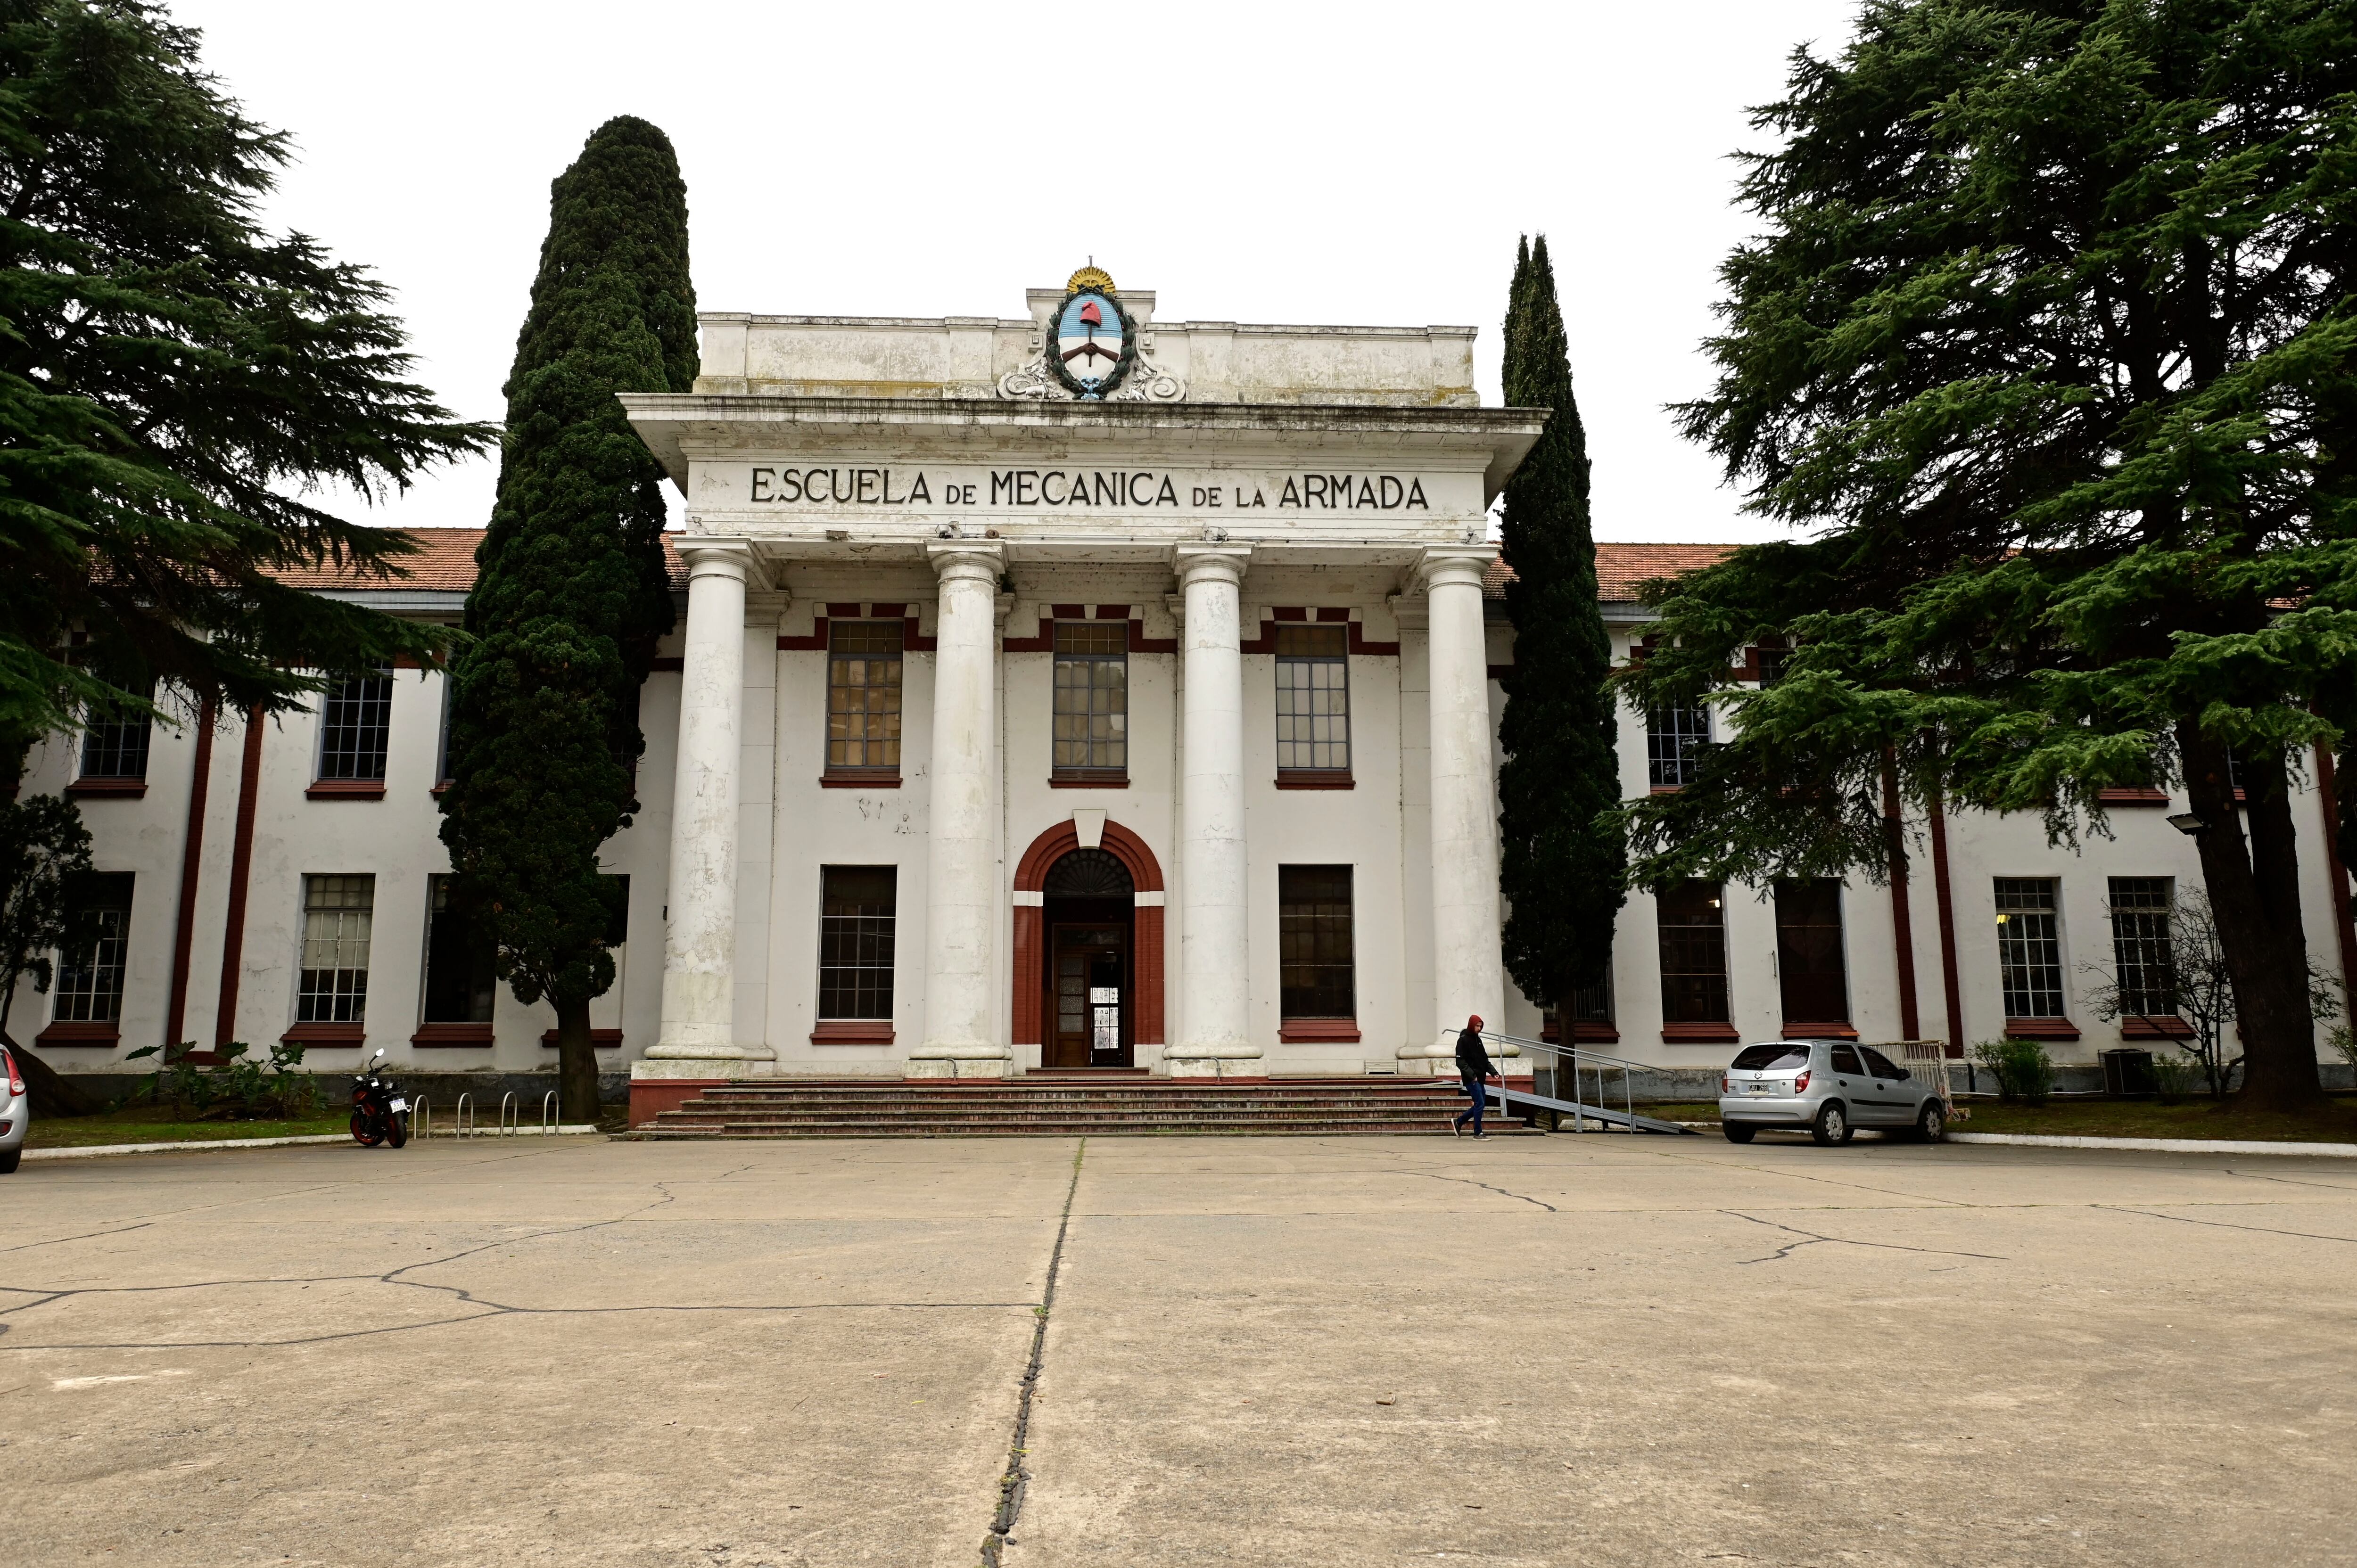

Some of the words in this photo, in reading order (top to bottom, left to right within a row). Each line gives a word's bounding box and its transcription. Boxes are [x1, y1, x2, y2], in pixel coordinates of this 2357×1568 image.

[751, 468, 932, 504] ESCUELA
[946, 484, 977, 505] DE
[990, 470, 1178, 506] MECANICA
[1193, 487, 1222, 507] DE
[1236, 487, 1266, 507] LA
[1279, 474, 1429, 509] ARMADA
